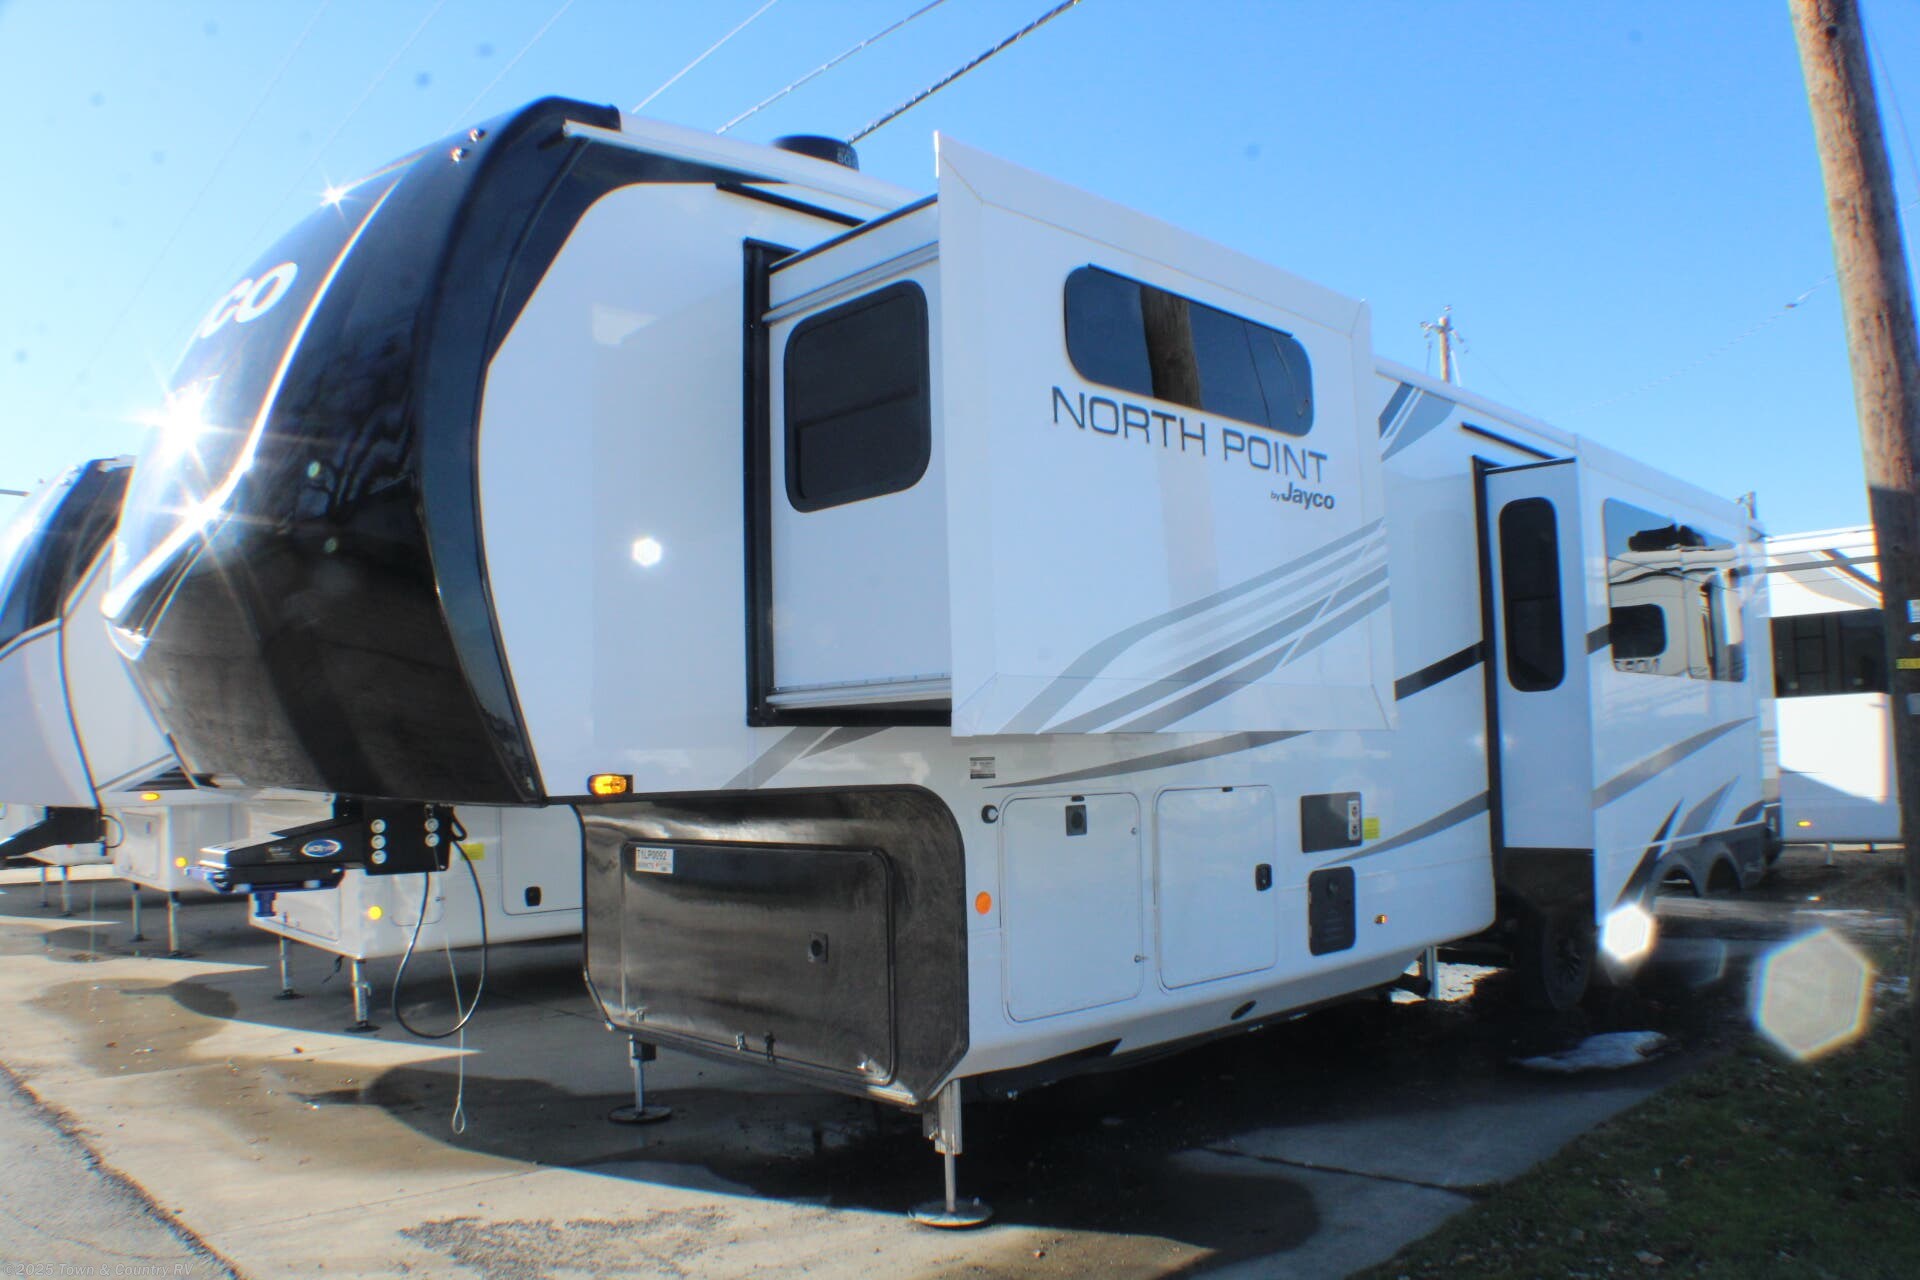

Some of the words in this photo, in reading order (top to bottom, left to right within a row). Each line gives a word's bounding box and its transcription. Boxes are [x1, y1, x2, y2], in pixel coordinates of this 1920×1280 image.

[1052, 386, 1206, 456] NORTH
[1222, 428, 1328, 484] POINT
[1270, 490, 1281, 501] by
[1281, 482, 1335, 510] Jayco
